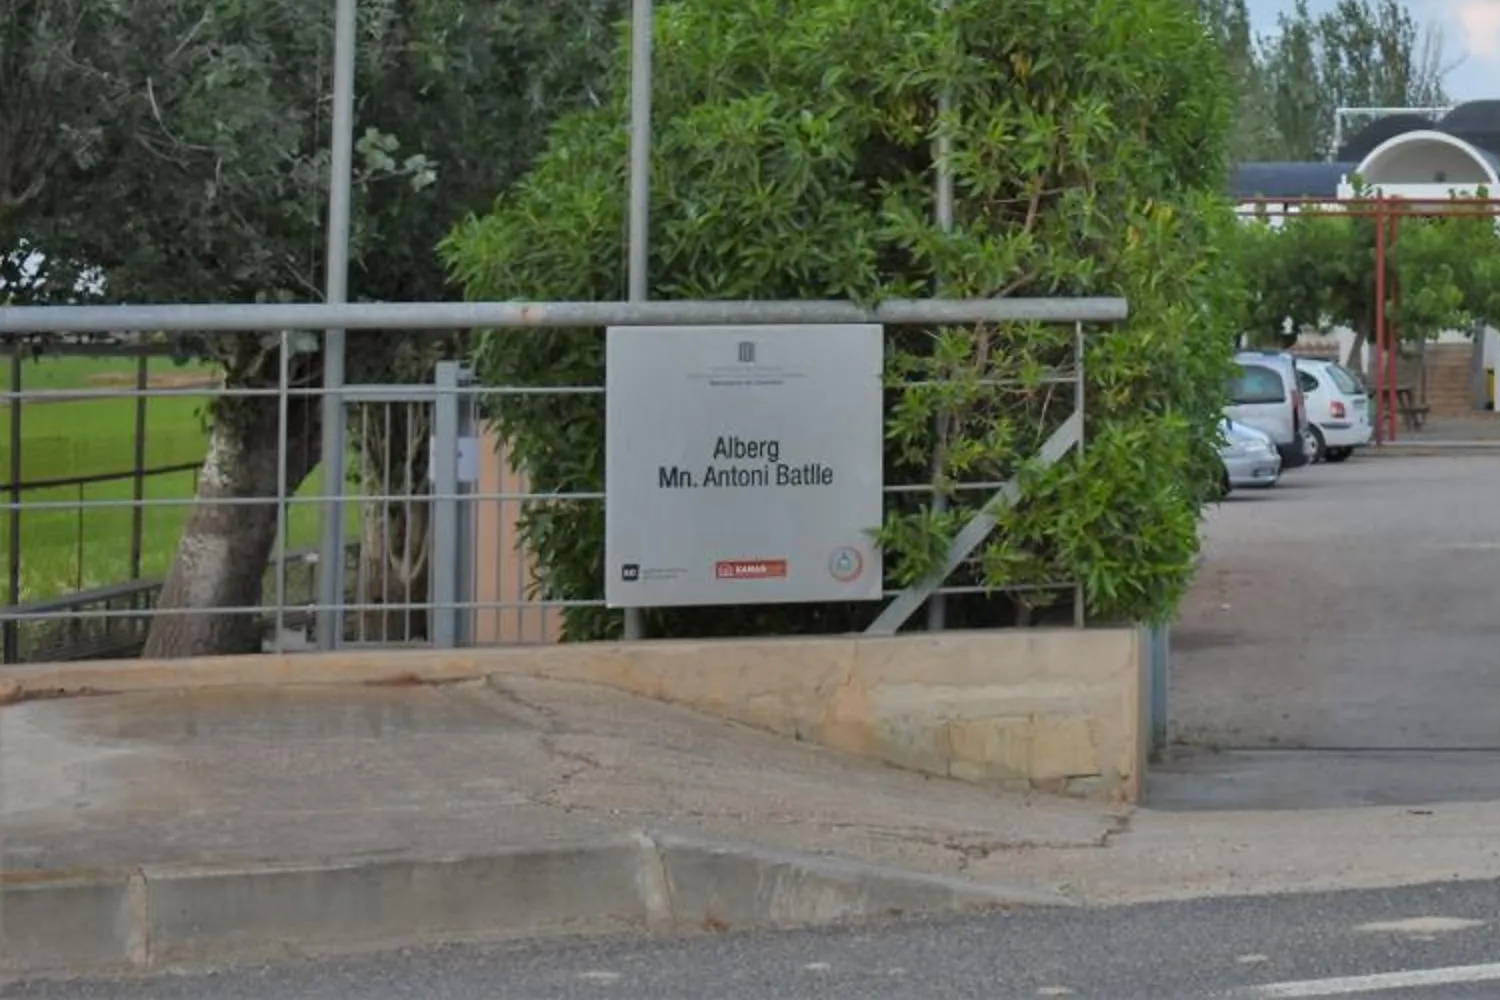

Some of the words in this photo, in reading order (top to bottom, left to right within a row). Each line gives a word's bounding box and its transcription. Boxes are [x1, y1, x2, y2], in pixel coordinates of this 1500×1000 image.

[713, 436, 779, 462] Alberg
[658, 466, 698, 488] Mn.
[703, 465, 769, 487] Antoni
[775, 463, 833, 486] Batlle
